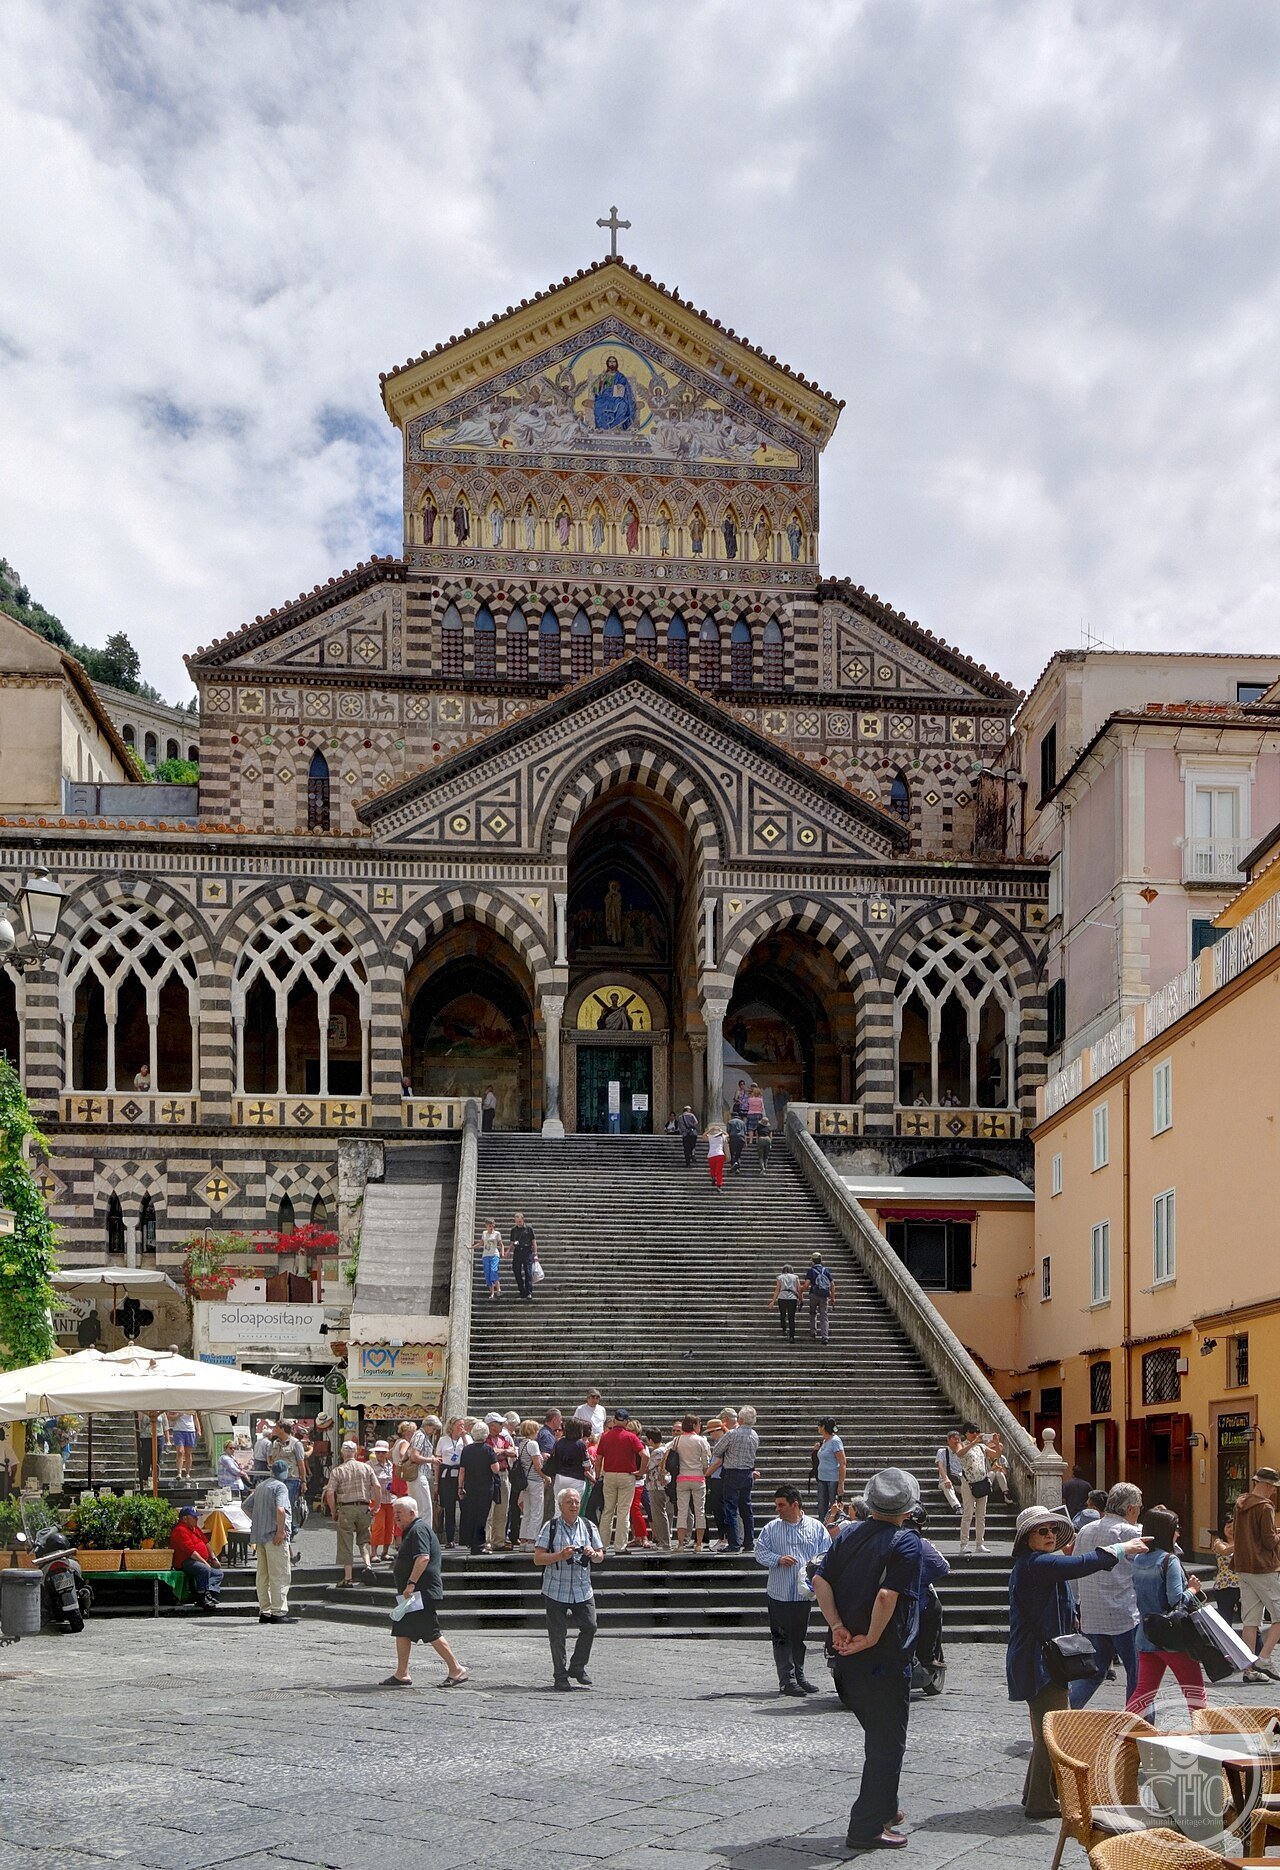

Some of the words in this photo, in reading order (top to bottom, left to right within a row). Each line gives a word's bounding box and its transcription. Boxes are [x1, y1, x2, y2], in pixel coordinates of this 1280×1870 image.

[221, 1308, 313, 1328] soloapositano
[270, 1363, 293, 1377] Cosy
[363, 1368, 395, 1376] Yogurtology
[287, 1371, 325, 1383] Accesso
[380, 1391, 413, 1399] Yogurtology
